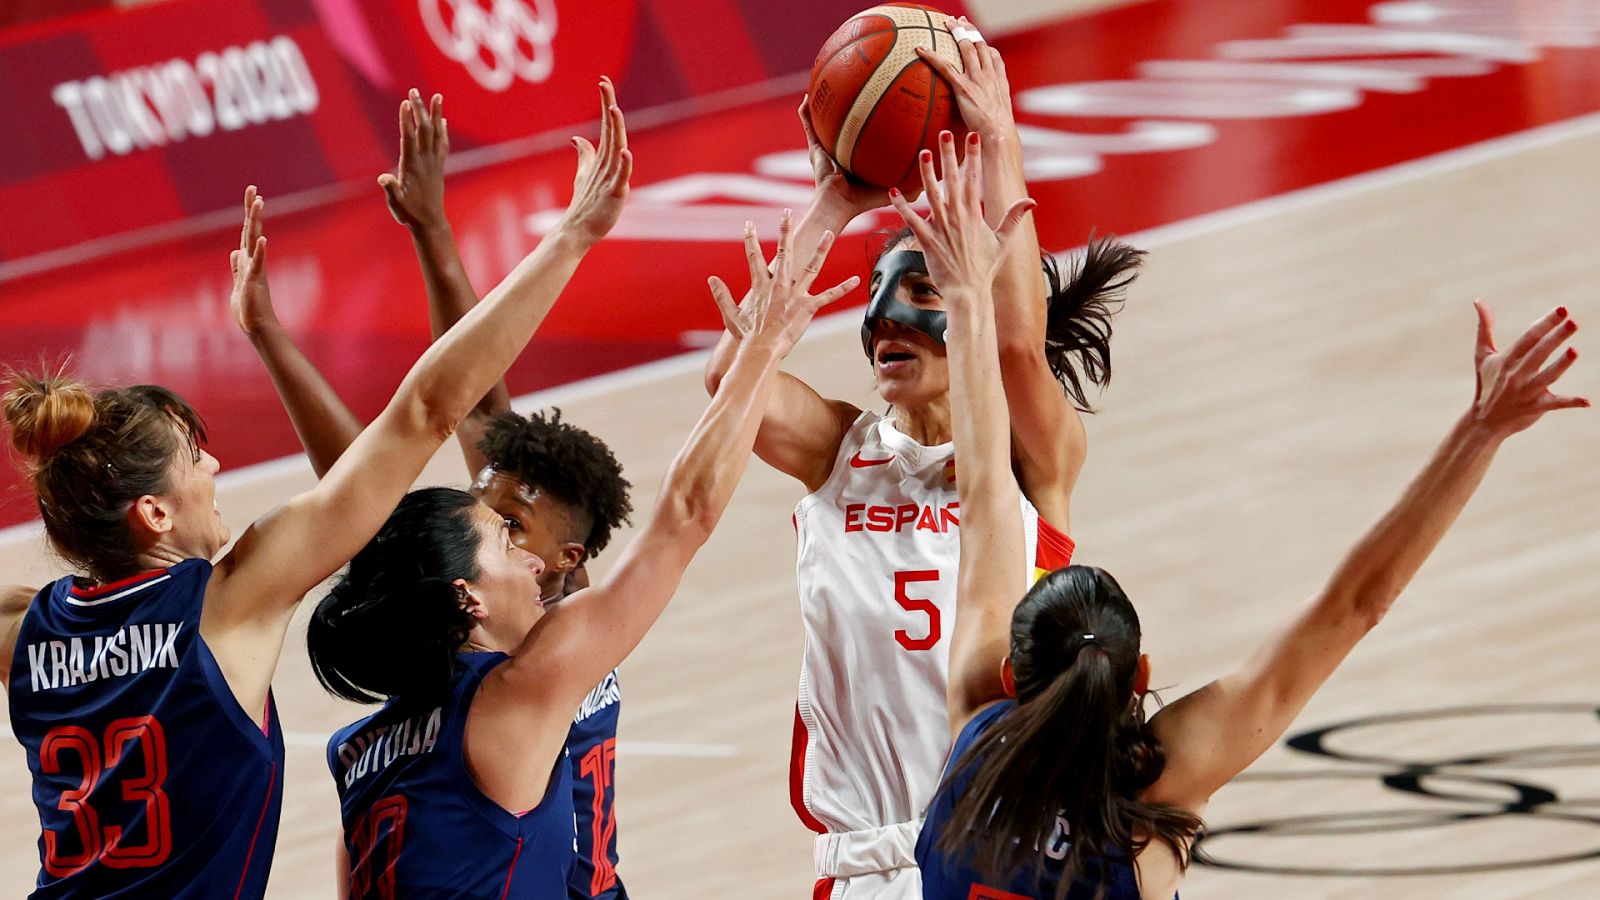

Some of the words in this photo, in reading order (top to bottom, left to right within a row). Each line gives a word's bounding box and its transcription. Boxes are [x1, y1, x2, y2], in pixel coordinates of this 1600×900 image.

[53, 58, 214, 160] TOKYO
[196, 35, 319, 131] 2020
[844, 502, 960, 532] ESPAÑ
[894, 569, 941, 651] 5
[39, 714, 172, 878] 33
